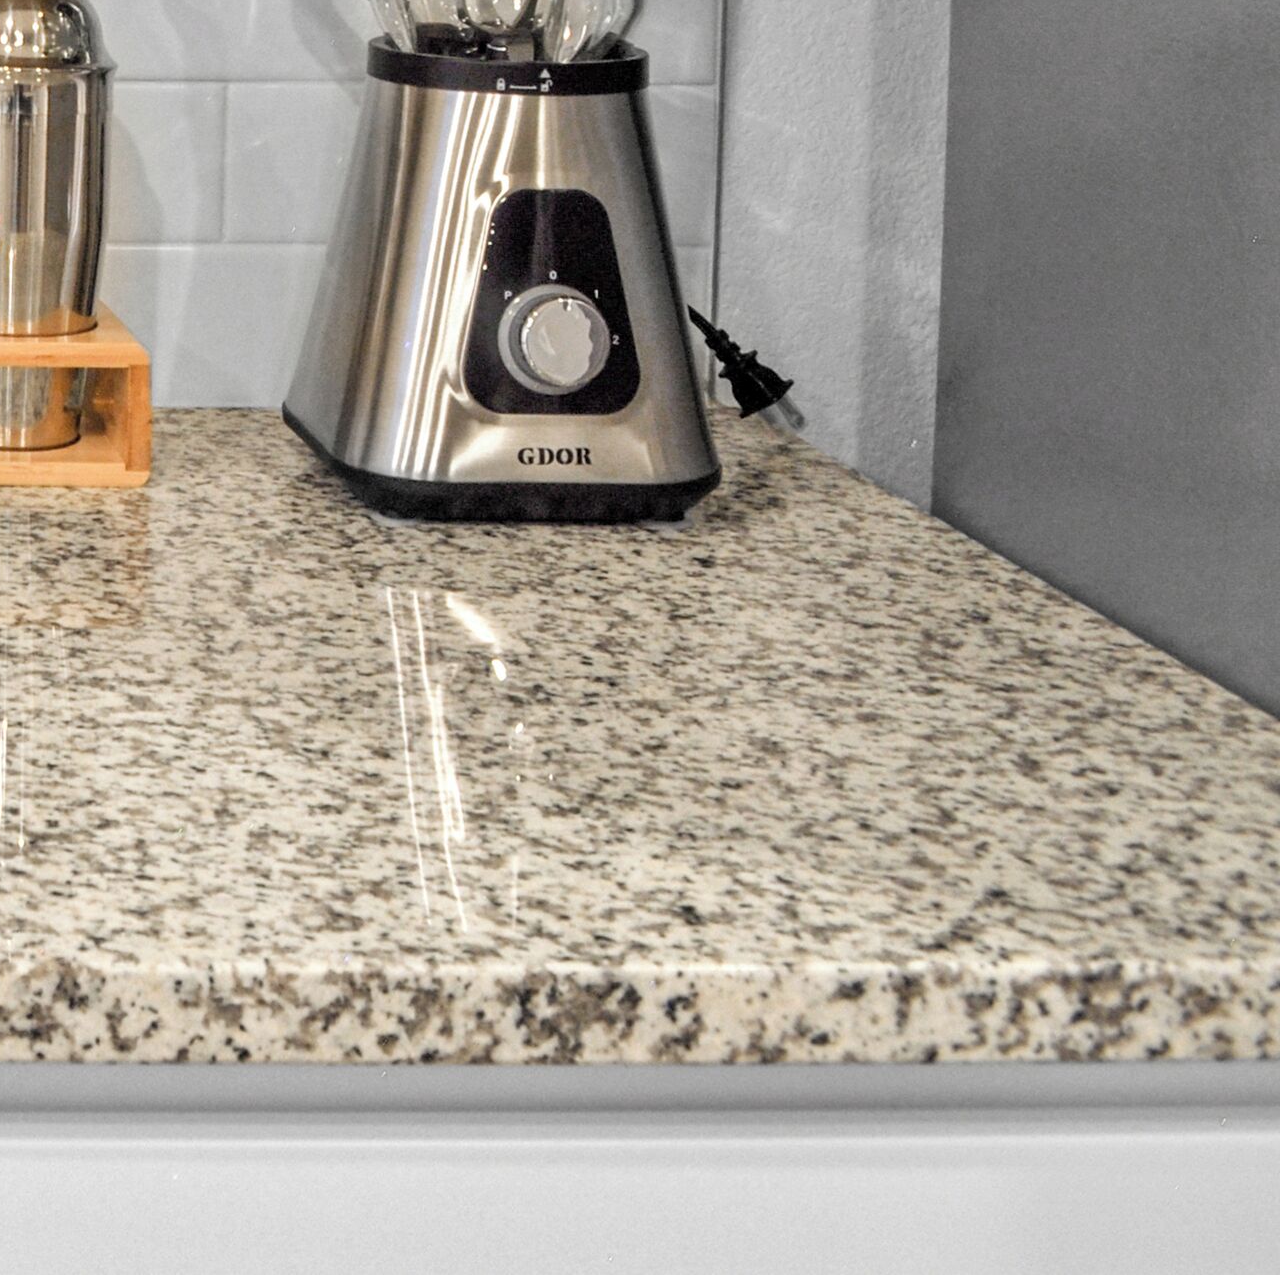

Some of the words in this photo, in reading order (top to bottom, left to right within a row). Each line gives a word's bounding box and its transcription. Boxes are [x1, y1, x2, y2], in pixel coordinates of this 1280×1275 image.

[504, 291, 513, 299] P
[594, 289, 600, 299] 1
[612, 335, 620, 345] 2
[517, 447, 593, 466] GDOR
